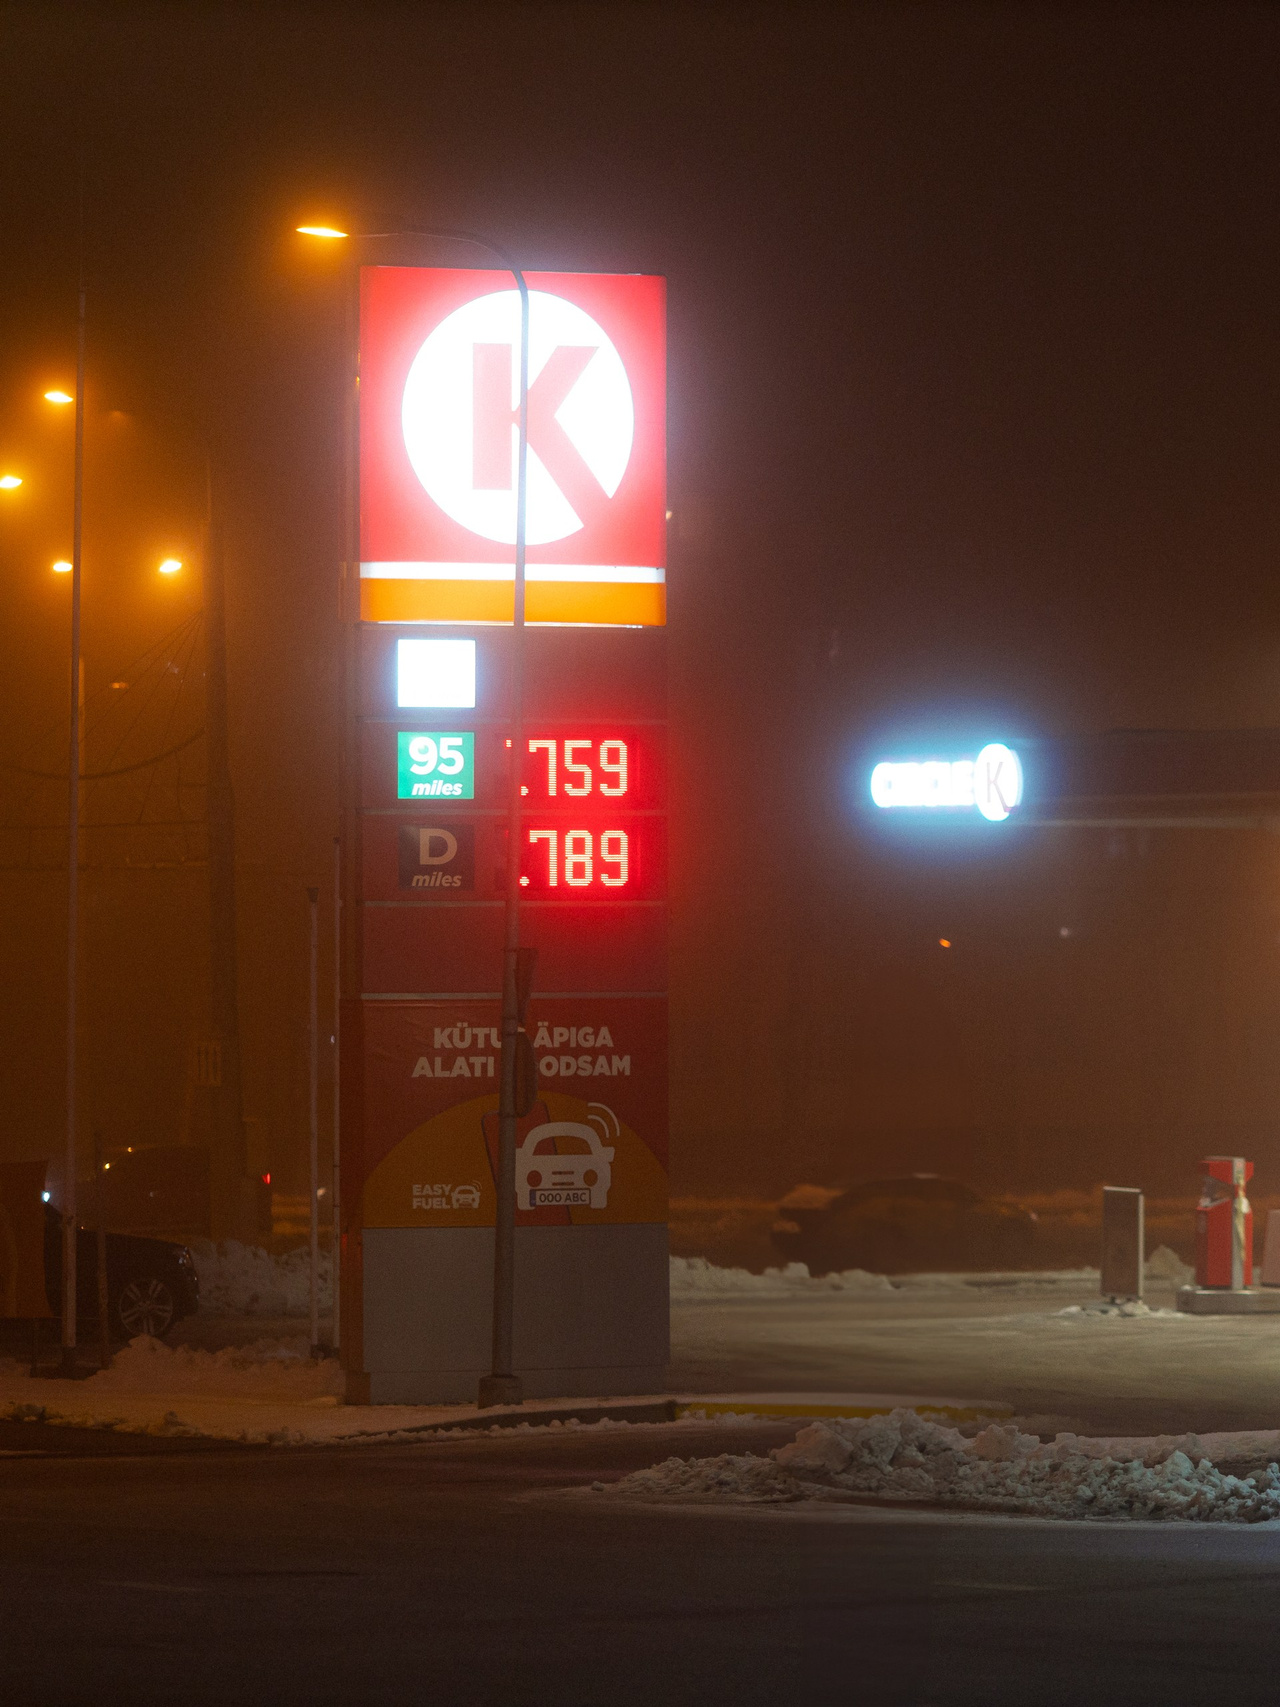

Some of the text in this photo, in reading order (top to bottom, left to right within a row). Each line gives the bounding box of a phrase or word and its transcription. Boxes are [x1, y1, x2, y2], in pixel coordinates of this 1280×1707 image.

[472, 342, 611, 528] K
[408, 736, 465, 775] 95
[505, 739, 628, 796] .759
[411, 780, 462, 796] miles
[419, 828, 458, 866] D
[505, 830, 628, 886] .789
[411, 872, 462, 888] miles
[434, 1021, 614, 1049] KÜTU ÄPIGA
[412, 1055, 631, 1078] ALATI ODSAM
[412, 1184, 452, 1197] EASY
[565, 1191, 587, 1204] ABC
[412, 1198, 450, 1210] FUEL
